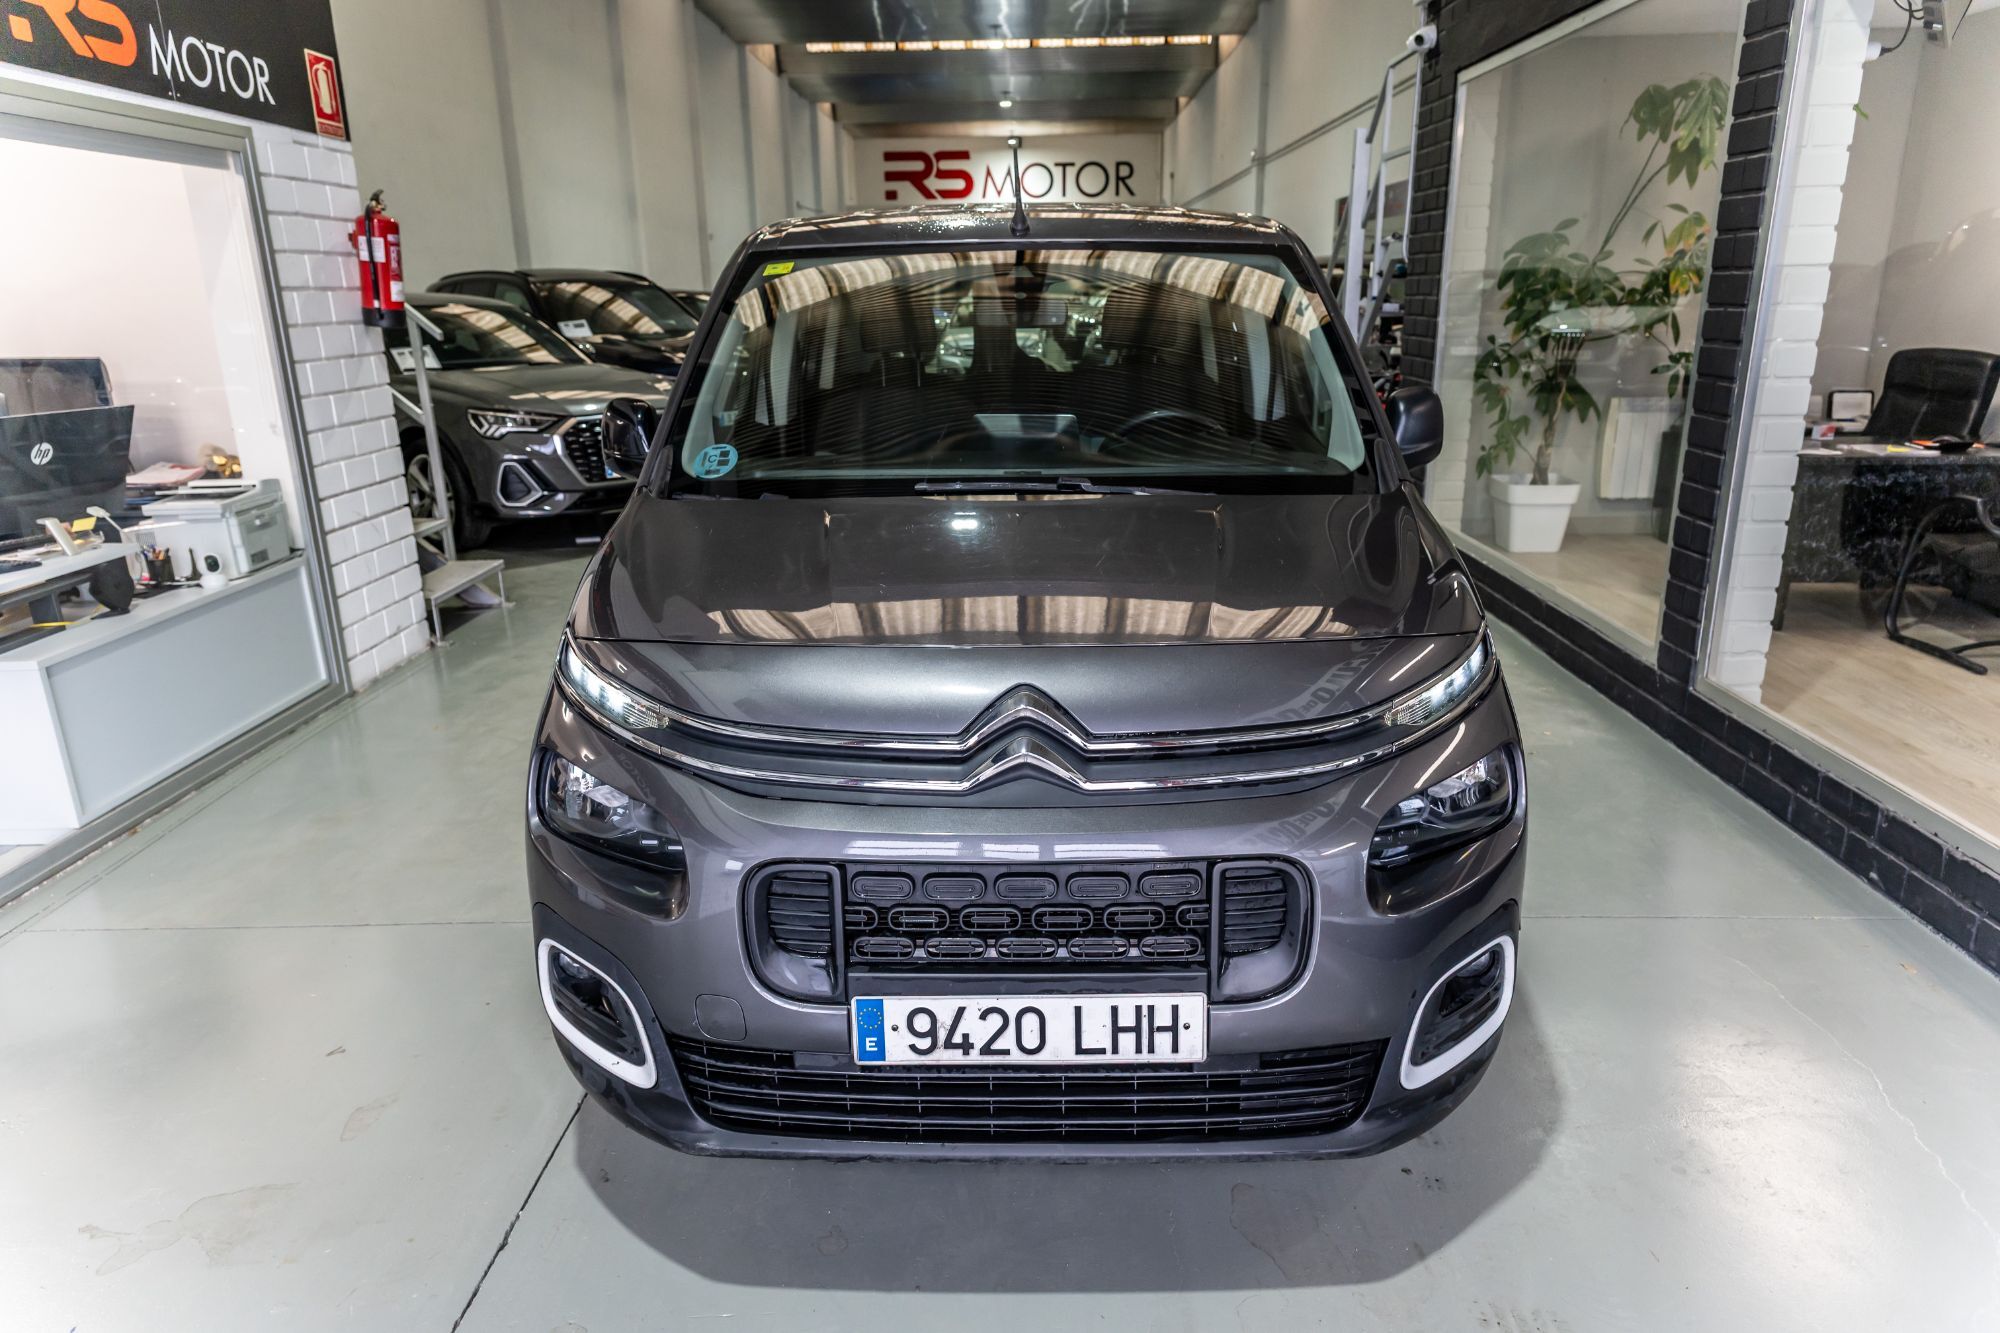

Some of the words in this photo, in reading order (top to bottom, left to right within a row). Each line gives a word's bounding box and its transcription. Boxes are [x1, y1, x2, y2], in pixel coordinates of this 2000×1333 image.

[149, 23, 276, 105] MOTOR
[883, 150, 974, 200] RS
[982, 161, 1136, 198] MOTOR
[32, 442, 52, 465] hp
[865, 1037, 878, 1051] E
[906, 1006, 1047, 1056] 9420
[1074, 1004, 1180, 1056] LHH
